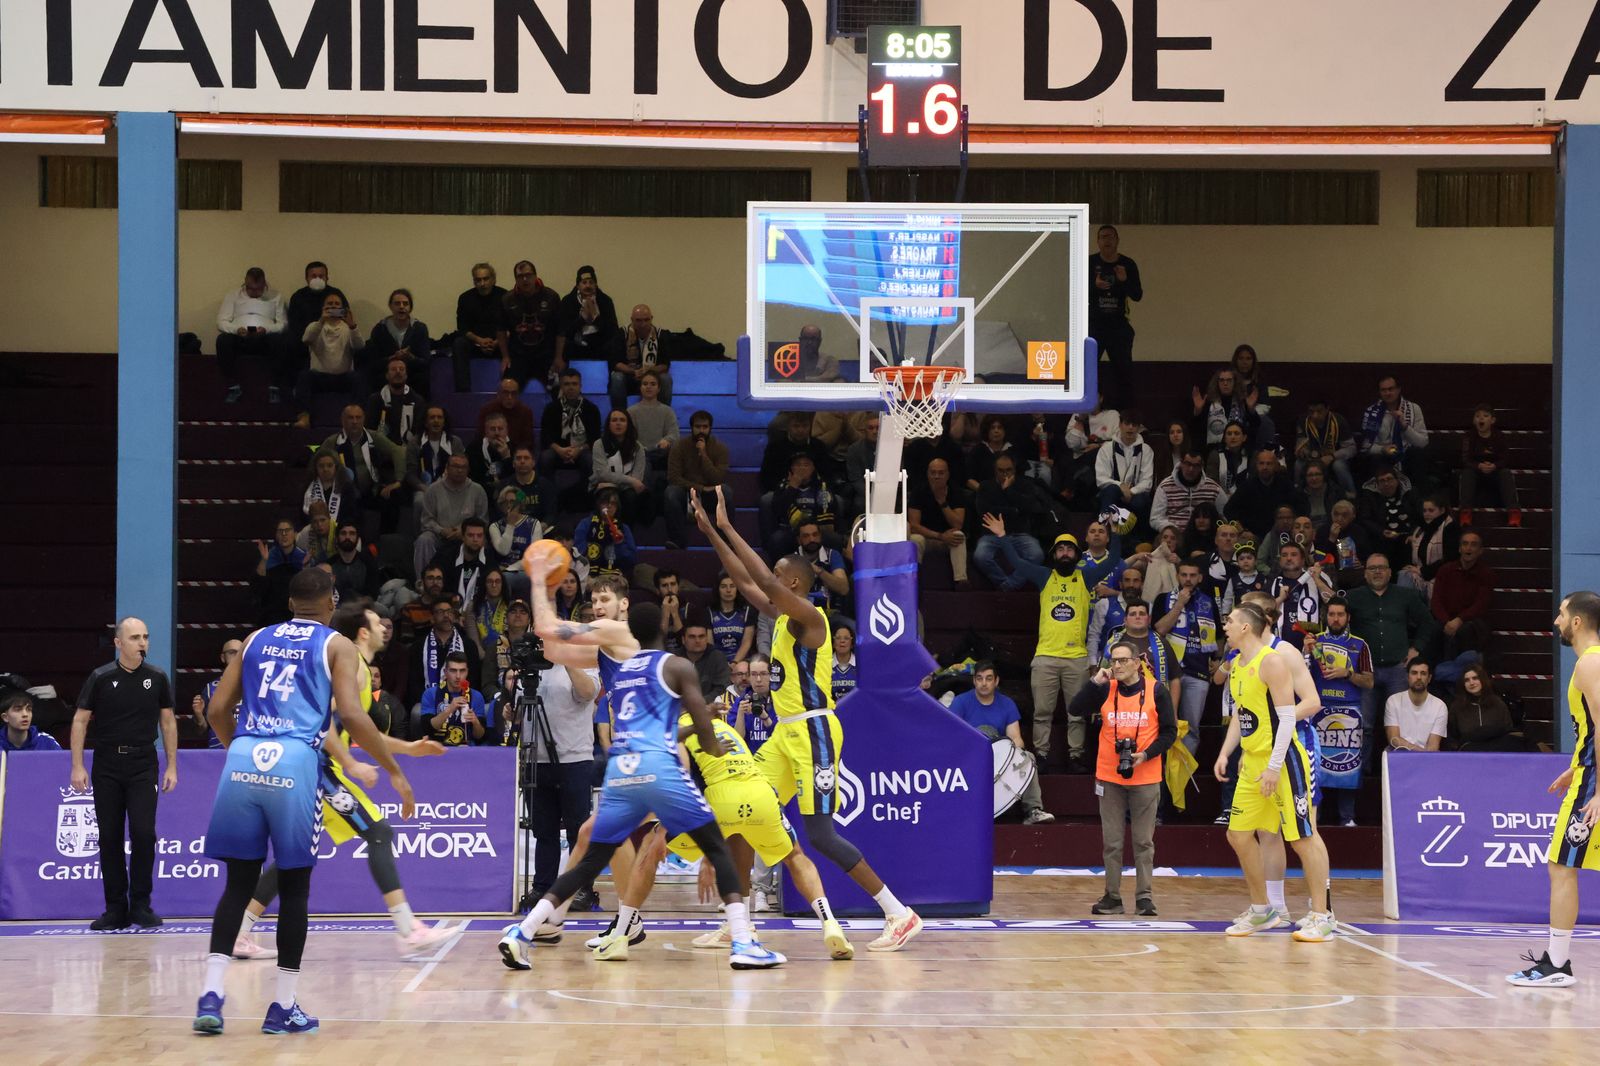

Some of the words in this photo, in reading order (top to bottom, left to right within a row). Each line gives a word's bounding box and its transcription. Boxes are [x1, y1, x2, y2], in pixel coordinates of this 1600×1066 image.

[886, 32, 952, 59] 8:05
[1024, 0, 1225, 102] DE
[871, 83, 959, 135] 1.6
[1060, 583, 1067, 593] 3
[261, 644, 307, 660] HEARST
[430, 649, 438, 669] CLUB
[257, 660, 298, 702] 14
[617, 690, 638, 721] 6
[1317, 730, 1363, 748] RENS
[230, 771, 295, 789] MORALEJO
[870, 767, 969, 796] INNOVA
[872, 801, 922, 825] Chef
[157, 859, 220, 879] León
